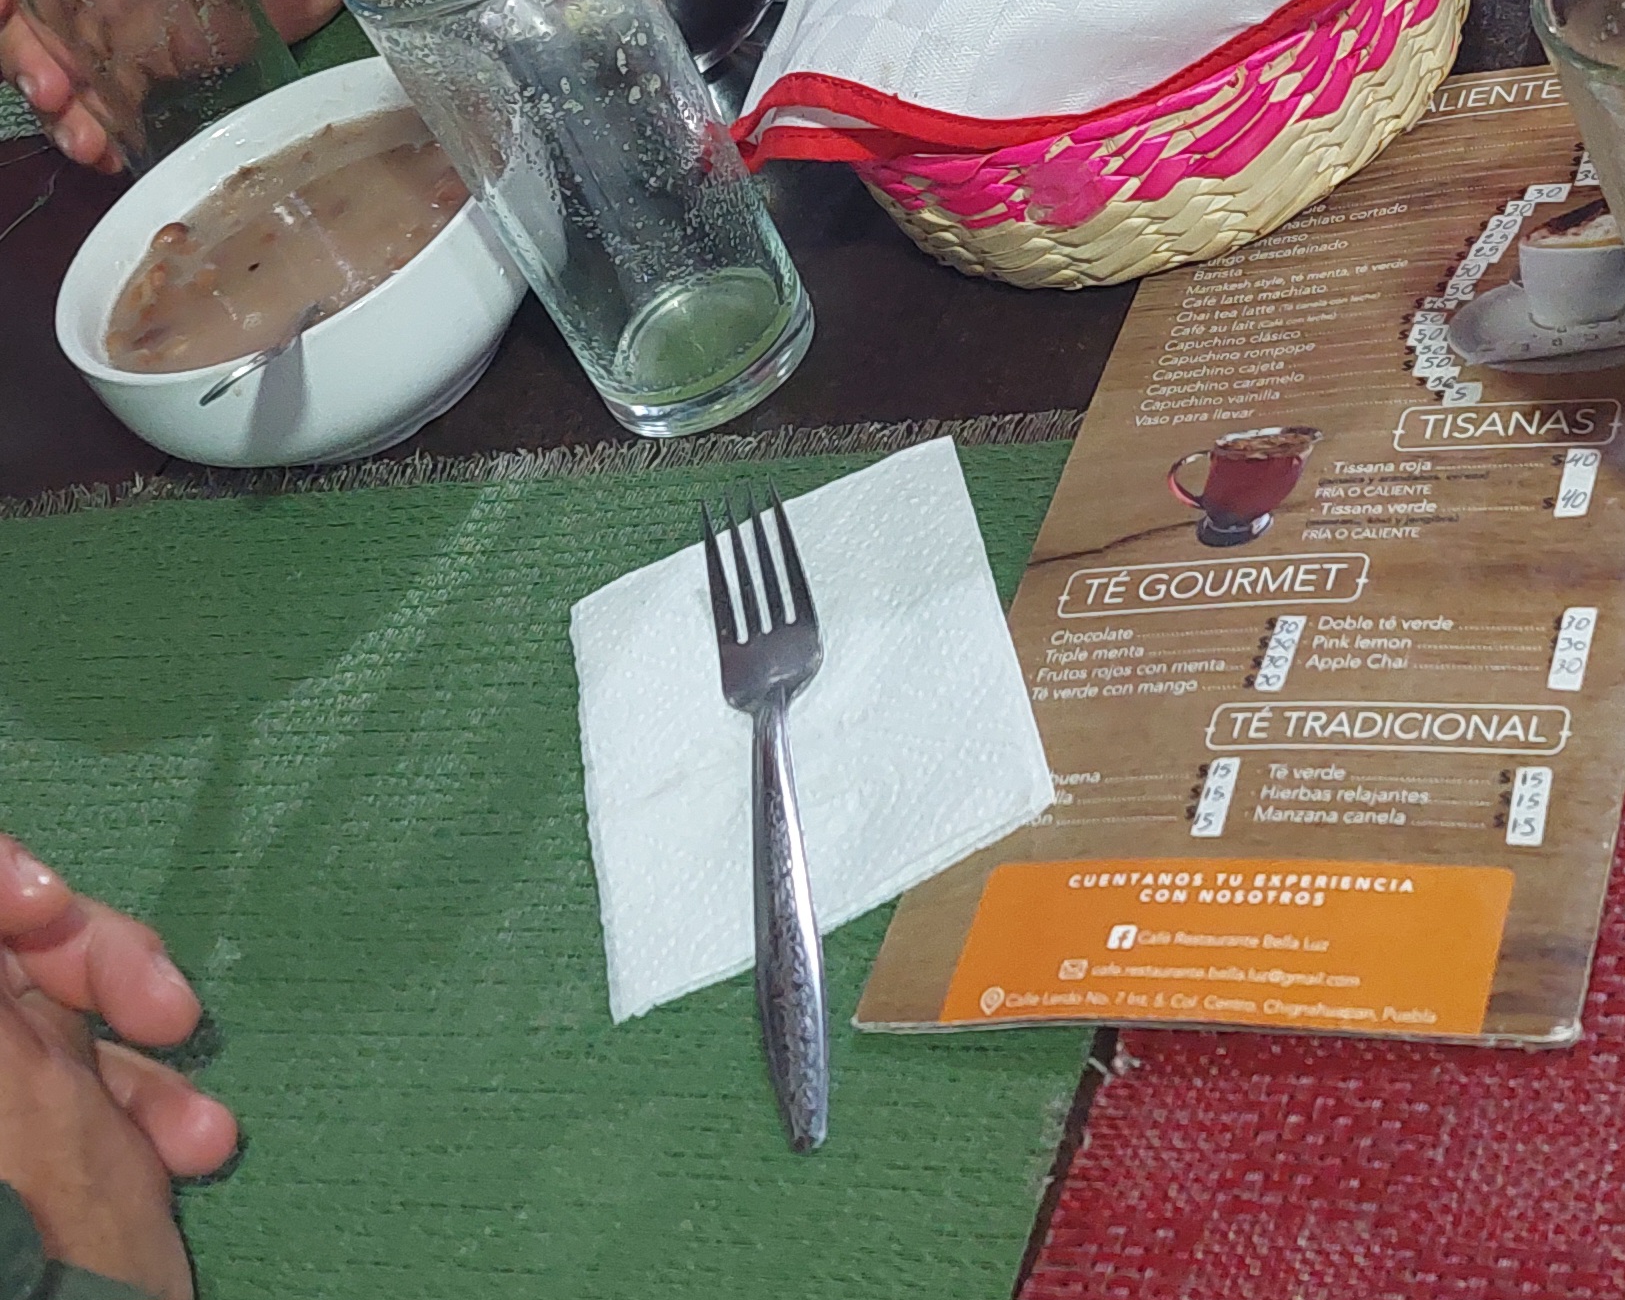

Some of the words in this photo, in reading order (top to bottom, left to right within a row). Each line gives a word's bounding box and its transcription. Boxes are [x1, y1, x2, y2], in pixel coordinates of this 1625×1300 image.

[1426, 78, 1563, 113] ALIENTE
[1349, 203, 1408, 222] cortado
[1249, 240, 1349, 261] descafeinado
[1193, 268, 1244, 282] Barista
[1182, 296, 1217, 309] Café
[1220, 294, 1254, 305] latte
[1258, 284, 1327, 302] machiato
[1186, 279, 1252, 296] Marrakesh
[1176, 311, 1211, 323] Chai
[1214, 309, 1239, 320] tea
[1241, 304, 1276, 317] latte
[1170, 324, 1206, 337] Café
[1209, 325, 1228, 334] au
[1231, 320, 1256, 332] lait
[1164, 336, 1246, 353] Capuchino
[1250, 330, 1301, 345] clásico
[1158, 351, 1240, 367] Capuchino
[1243, 342, 1316, 360] rompope
[1152, 366, 1234, 383] Capuchino
[1238, 360, 1285, 375] cajeta
[1146, 381, 1229, 398] Capuchino
[1233, 372, 1305, 389] caramelo
[1140, 395, 1223, 412] Capuchino
[1227, 390, 1281, 404] vainilla
[1134, 413, 1170, 427] Vaso
[1172, 410, 1208, 426] para
[1212, 408, 1256, 421] llevar
[1419, 408, 1597, 440] TISANAS
[1333, 461, 1395, 474] Tissana
[1399, 459, 1432, 475] roja
[1347, 485, 1361, 498] O
[1363, 484, 1433, 498] CALIENTE
[1321, 502, 1383, 515] Tissana
[1335, 527, 1348, 540] O
[1351, 526, 1421, 540] CALIENTE
[1085, 570, 1131, 605] TÉ
[1138, 563, 1349, 602] GOURMET
[1317, 615, 1374, 631] Doble
[1379, 615, 1397, 631] té
[1401, 615, 1454, 631] verde
[1050, 628, 1134, 646] Chocolate
[1312, 635, 1349, 650] Pink
[1354, 636, 1412, 650] lemon
[1046, 646, 1088, 666] Triple
[1092, 645, 1144, 660] menta
[1305, 654, 1362, 672] Apple
[1366, 653, 1408, 670] Chai
[1036, 667, 1088, 682] Frutos
[1092, 664, 1132, 681] rojos
[1136, 663, 1170, 676] con
[1171, 658, 1226, 673] menta
[1053, 683, 1099, 700] verde
[1102, 684, 1136, 697] con
[1138, 679, 1198, 698] mango
[1230, 705, 1273, 740] TÉ
[1284, 710, 1548, 744] TRADICIONAL
[1267, 763, 1288, 780] Té
[1293, 763, 1346, 782] verde
[1259, 785, 1332, 803] Hierbas
[1336, 786, 1431, 807] relajantes
[1253, 805, 1338, 824] Manzana
[1342, 806, 1407, 826] canela
[1068, 871, 1205, 889] CUENTANOS
[1215, 872, 1244, 887] TU
[1253, 872, 1415, 894] EXPERIENCIA
[1139, 888, 1189, 903] CON
[1197, 888, 1327, 907] NOSOTROS
